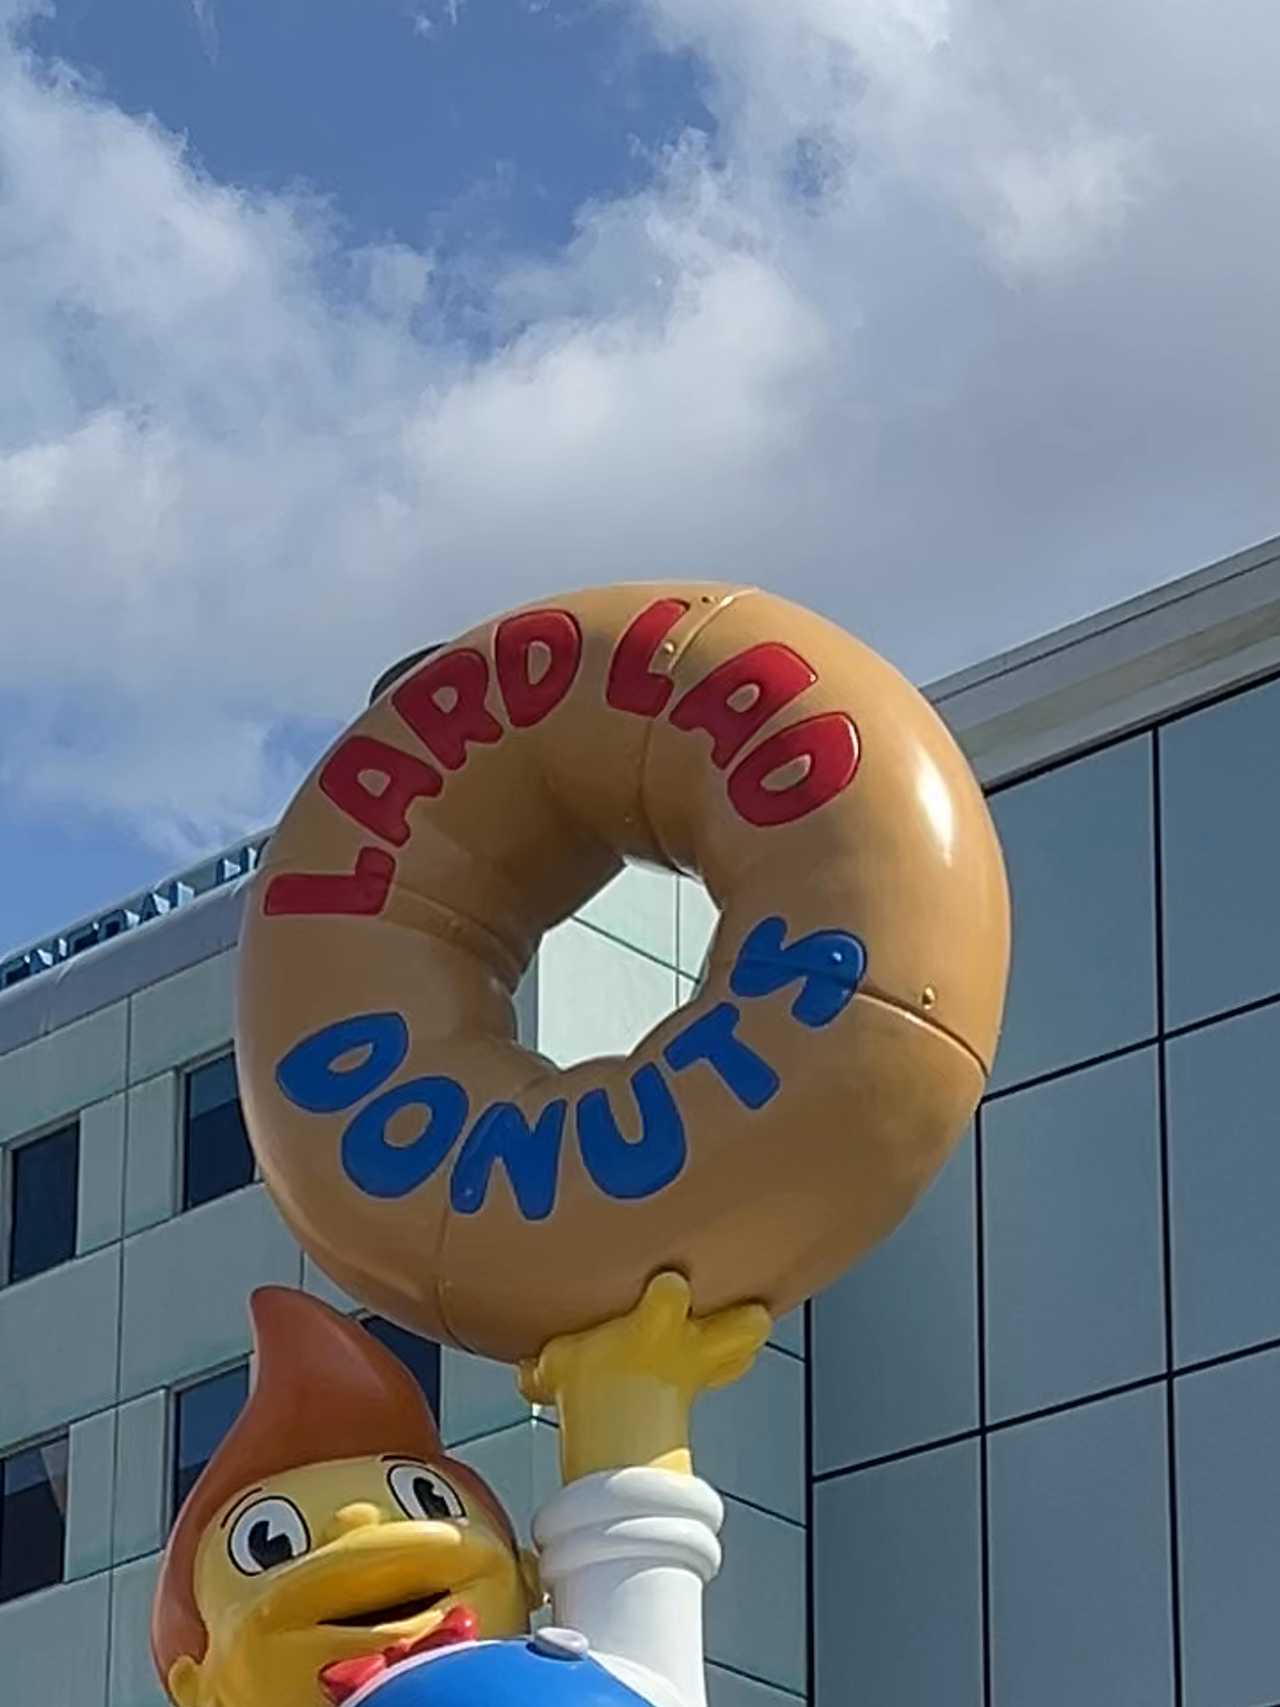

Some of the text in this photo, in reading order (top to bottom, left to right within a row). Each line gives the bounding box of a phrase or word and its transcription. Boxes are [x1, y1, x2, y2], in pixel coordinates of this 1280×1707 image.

[263, 598, 861, 916] LARD LAD
[273, 915, 868, 1222] DONUTS
